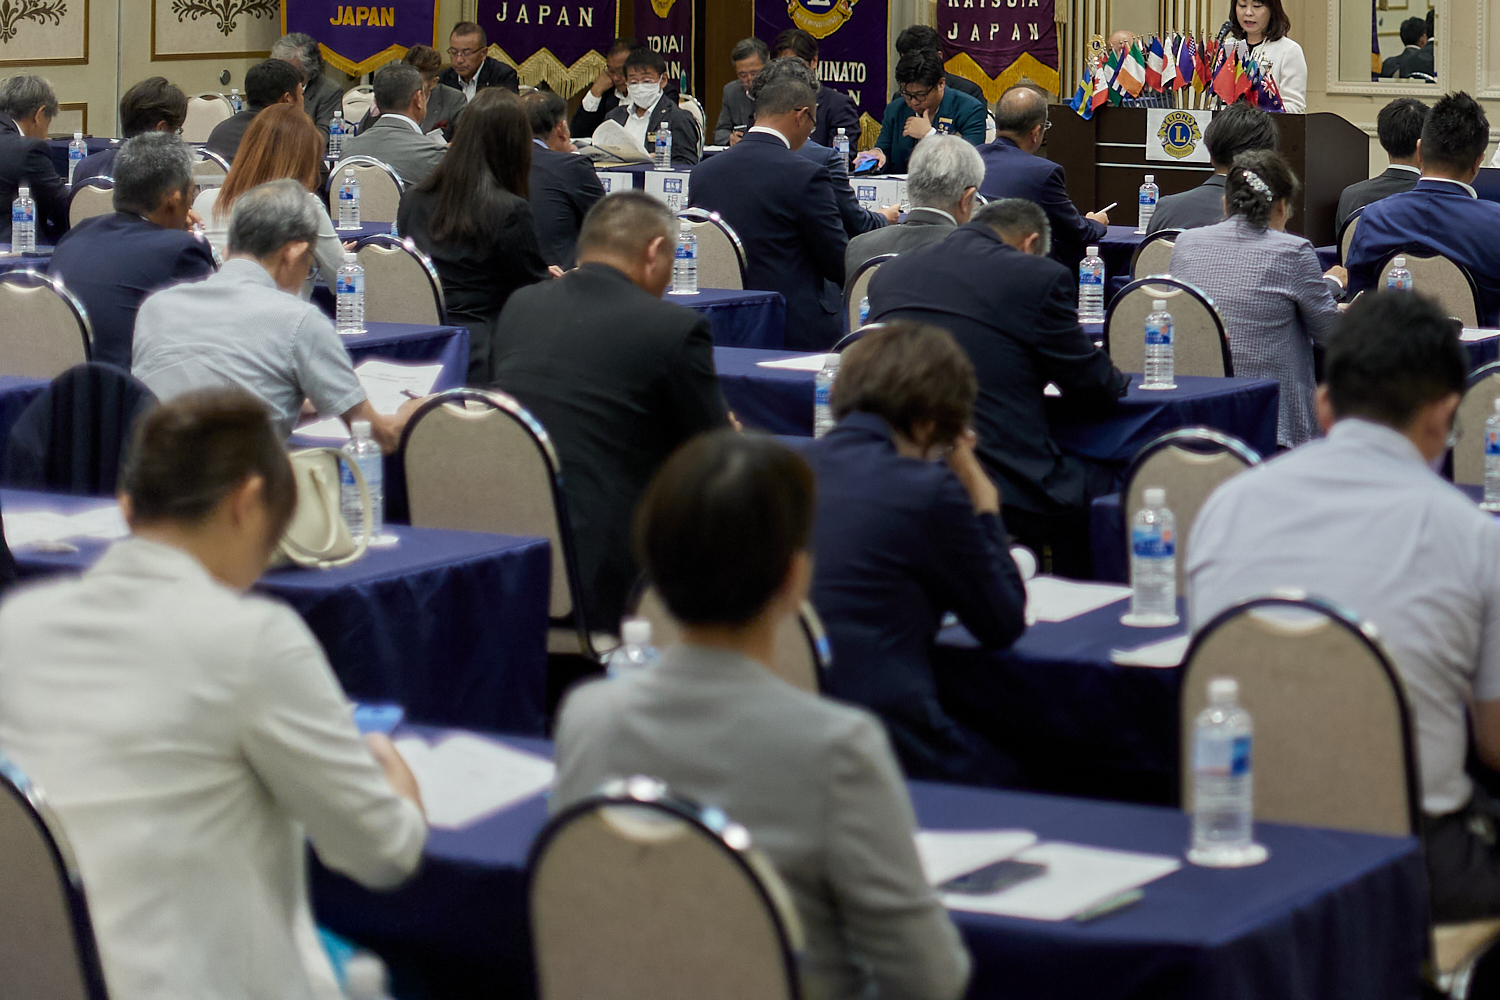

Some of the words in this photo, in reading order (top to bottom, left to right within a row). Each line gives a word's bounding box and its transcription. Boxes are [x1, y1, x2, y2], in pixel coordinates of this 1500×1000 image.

[329, 5, 395, 27] JAPAN
[496, 1, 594, 28] JAPAN
[947, 22, 1039, 42] JAPAN
[647, 35, 684, 54] TOKAI
[815, 60, 867, 84] MINATO
[1167, 113, 1193, 123] LIONS
